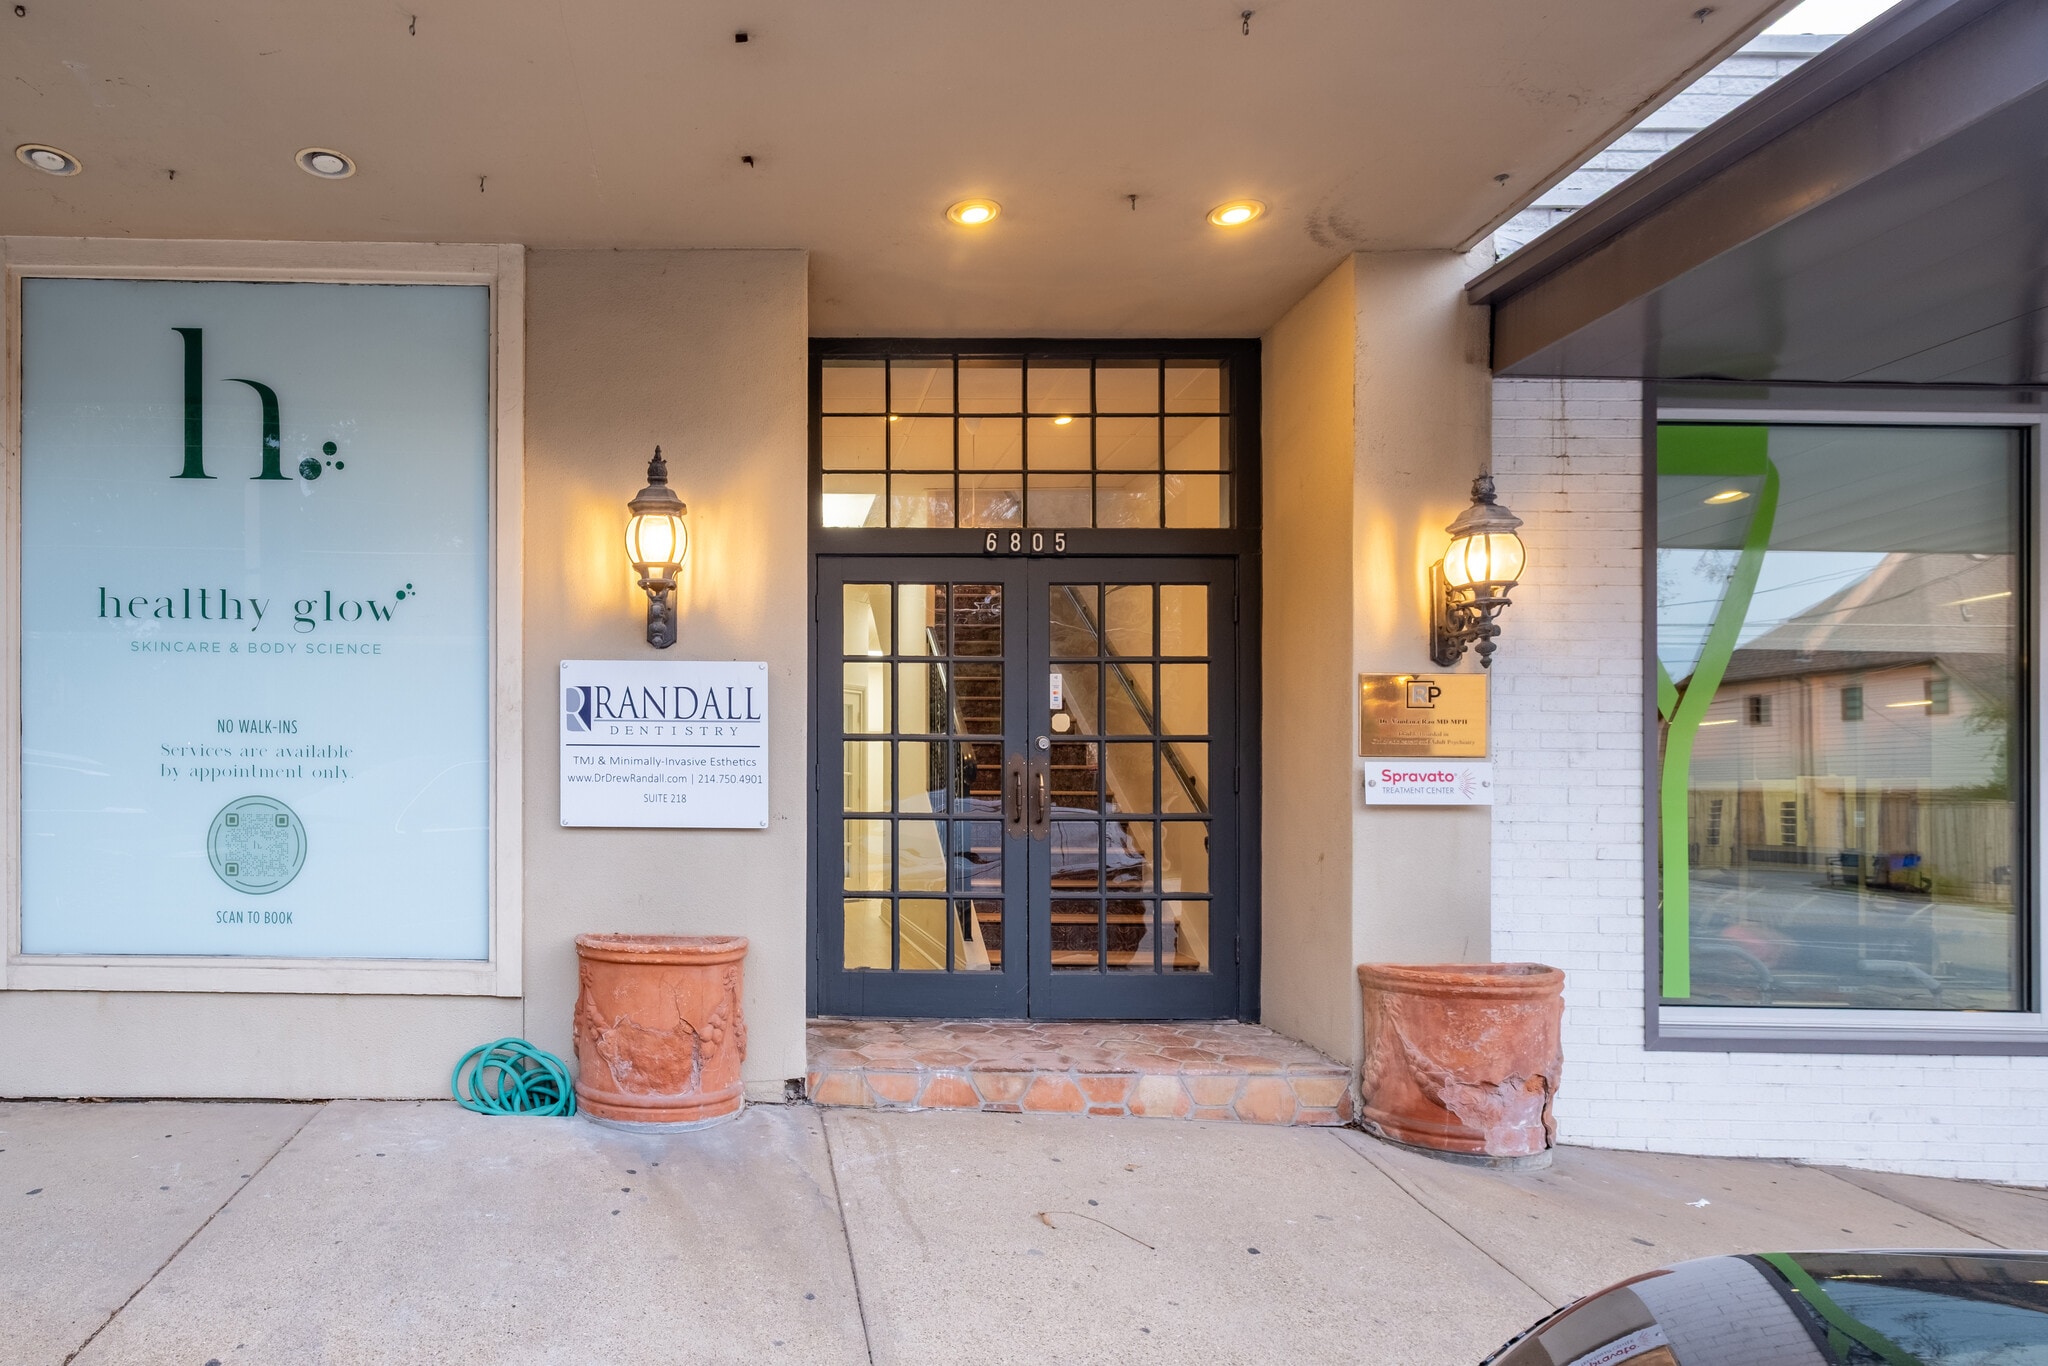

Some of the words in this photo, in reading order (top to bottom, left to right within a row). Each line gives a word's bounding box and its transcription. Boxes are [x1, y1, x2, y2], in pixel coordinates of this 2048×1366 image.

[985, 532, 1067, 552] 6805
[97, 586, 270, 632] healthy
[293, 590, 400, 634] glow
[130, 640, 221, 653] SKINCARE
[229, 642, 239, 653] &
[248, 642, 297, 654] BODY
[306, 643, 382, 655] SCIENCE
[594, 685, 762, 720] RANDALL
[217, 719, 234, 734] NO
[238, 719, 298, 734] WALK-INS
[610, 725, 739, 737] DENTISTRY
[161, 742, 232, 758] Services
[239, 748, 268, 758] are
[275, 744, 353, 759] available
[573, 755, 594, 766] TMJ
[598, 756, 606, 766] &
[610, 755, 707, 768] Minimally-Invasive
[710, 757, 757, 767] Esthetics
[161, 763, 179, 782] by
[189, 764, 303, 782] appointment
[312, 765, 354, 784] only.
[567, 773, 688, 784] www.DrDrewRandall.com
[698, 774, 763, 785] 214.750.4901
[1381, 768, 1455, 785] Spravato
[1382, 786, 1426, 795] TREATMENT
[1426, 786, 1455, 795] CENTER
[643, 793, 668, 803] SUITE
[670, 794, 687, 804] 218
[216, 910, 243, 924] SCAN
[247, 911, 260, 924] TO
[264, 911, 293, 925] BOOK
